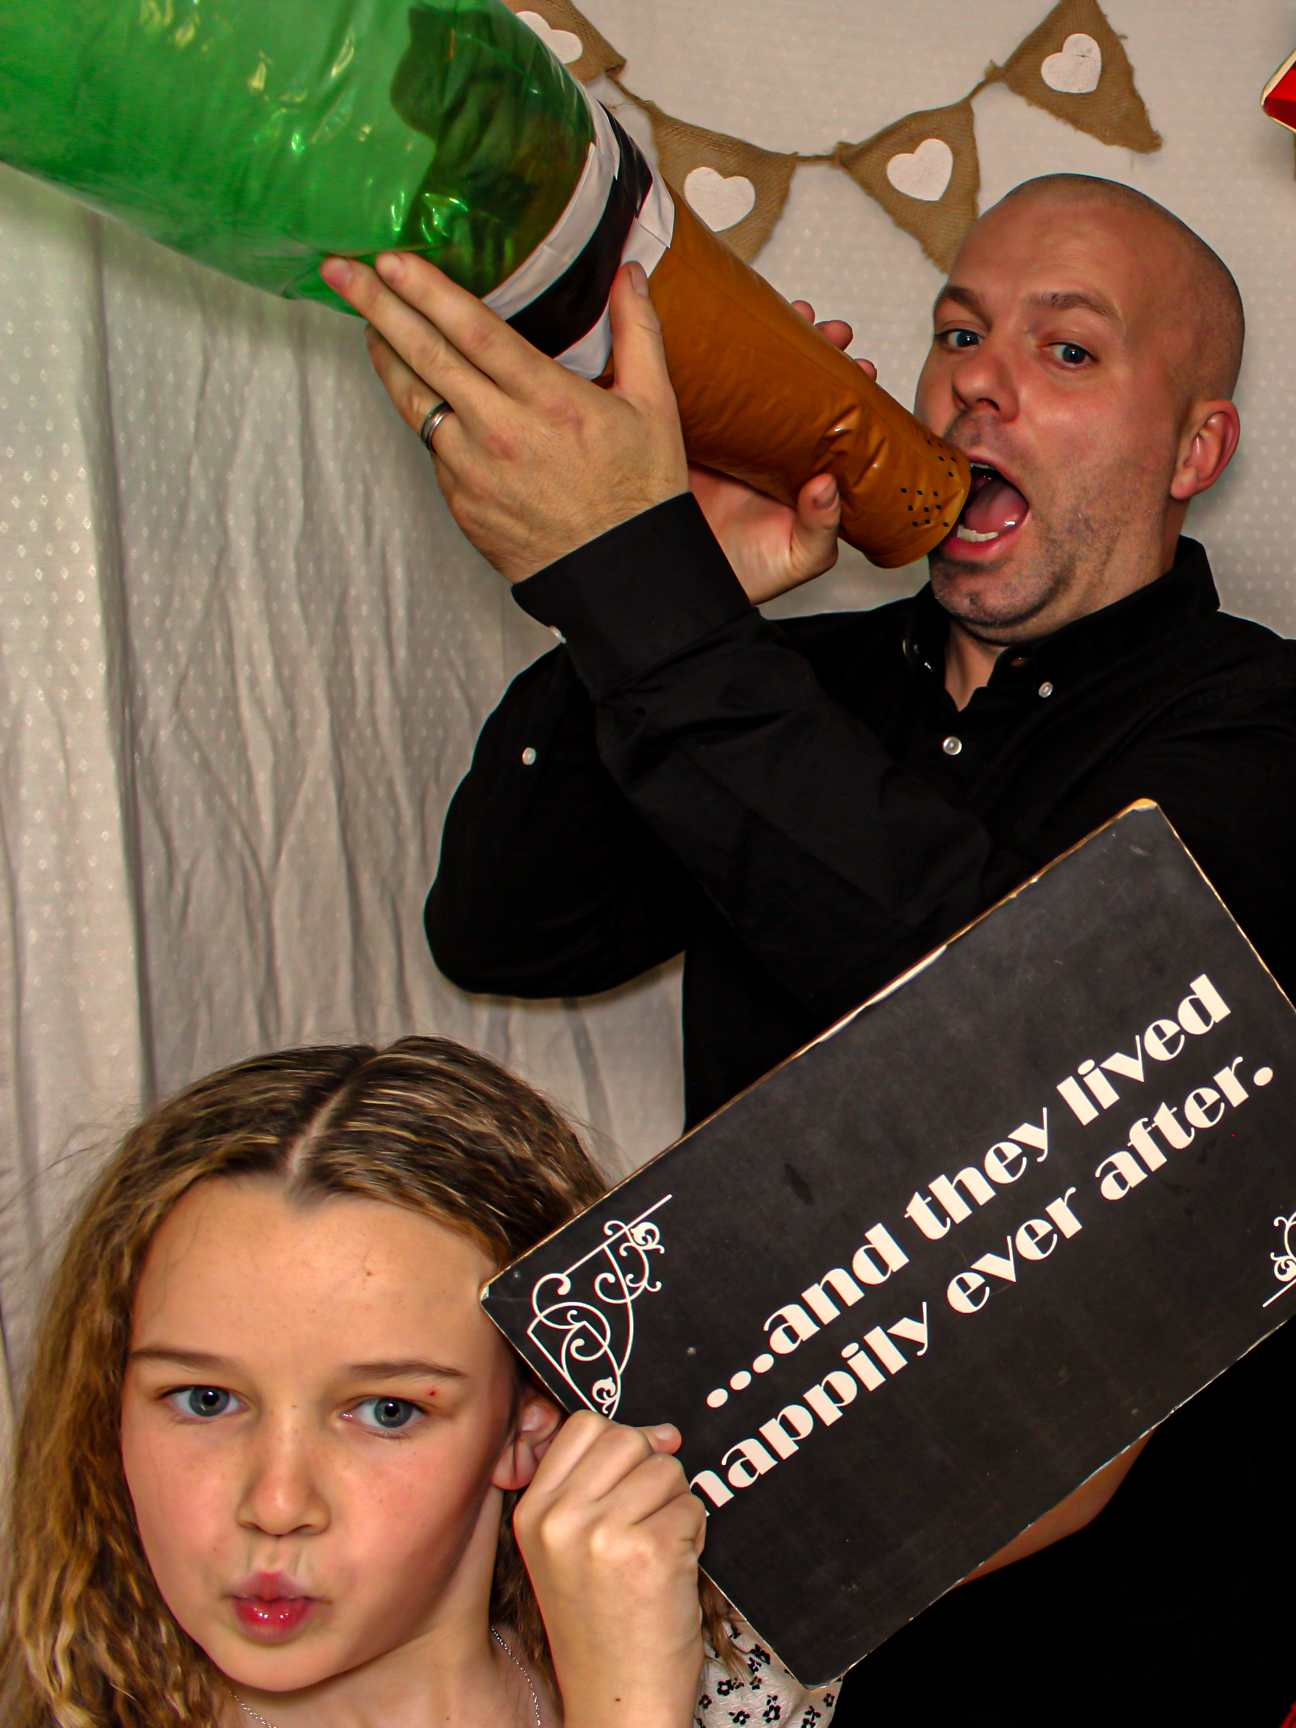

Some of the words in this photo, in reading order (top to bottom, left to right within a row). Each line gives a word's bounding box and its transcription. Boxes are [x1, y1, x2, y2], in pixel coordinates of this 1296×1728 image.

[903, 1106, 1049, 1240] they
[1056, 973, 1232, 1126] lived
[946, 1186, 1083, 1314] ever
[1095, 1056, 1274, 1201] after.
